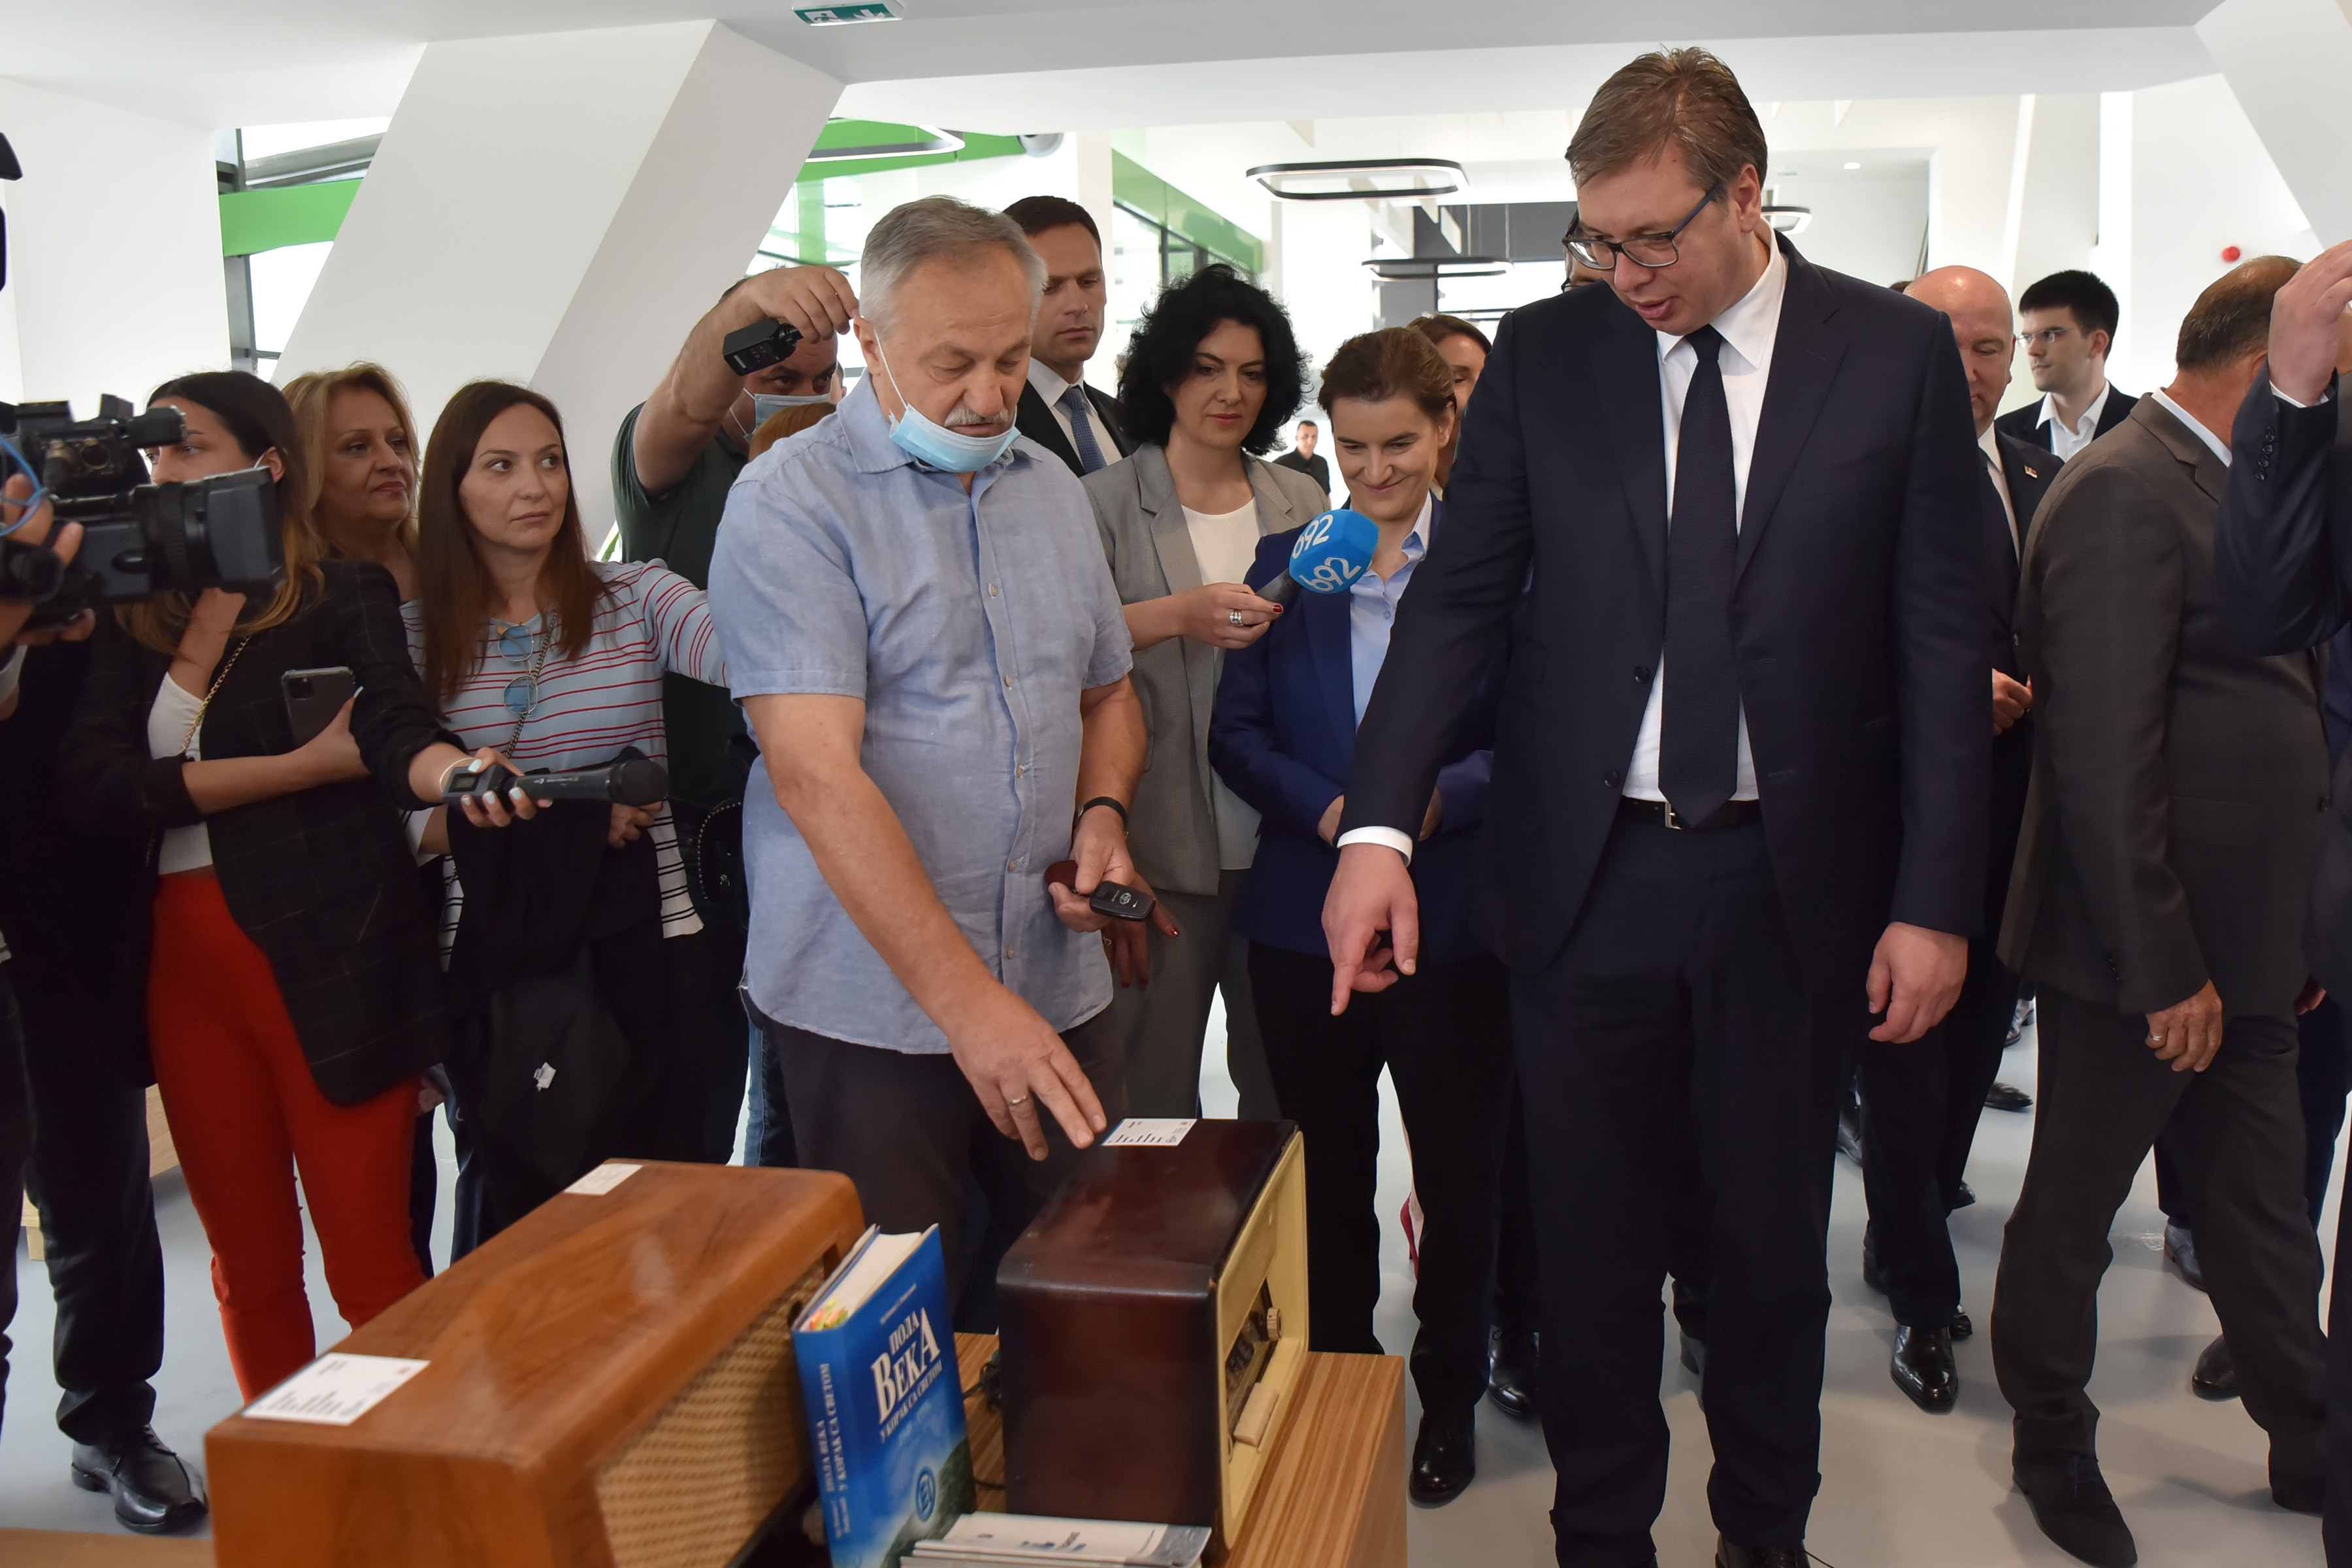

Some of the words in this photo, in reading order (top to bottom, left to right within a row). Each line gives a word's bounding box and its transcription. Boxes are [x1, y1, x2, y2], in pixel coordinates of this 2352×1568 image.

[1299, 557, 1362, 592] b92
[889, 1310, 920, 1357] ПОЛА
[870, 1306, 941, 1425] ВЕКА
[819, 1362, 837, 1417] СВЕТОМ
[907, 1391, 918, 1409] СА
[828, 1416, 840, 1437] СА
